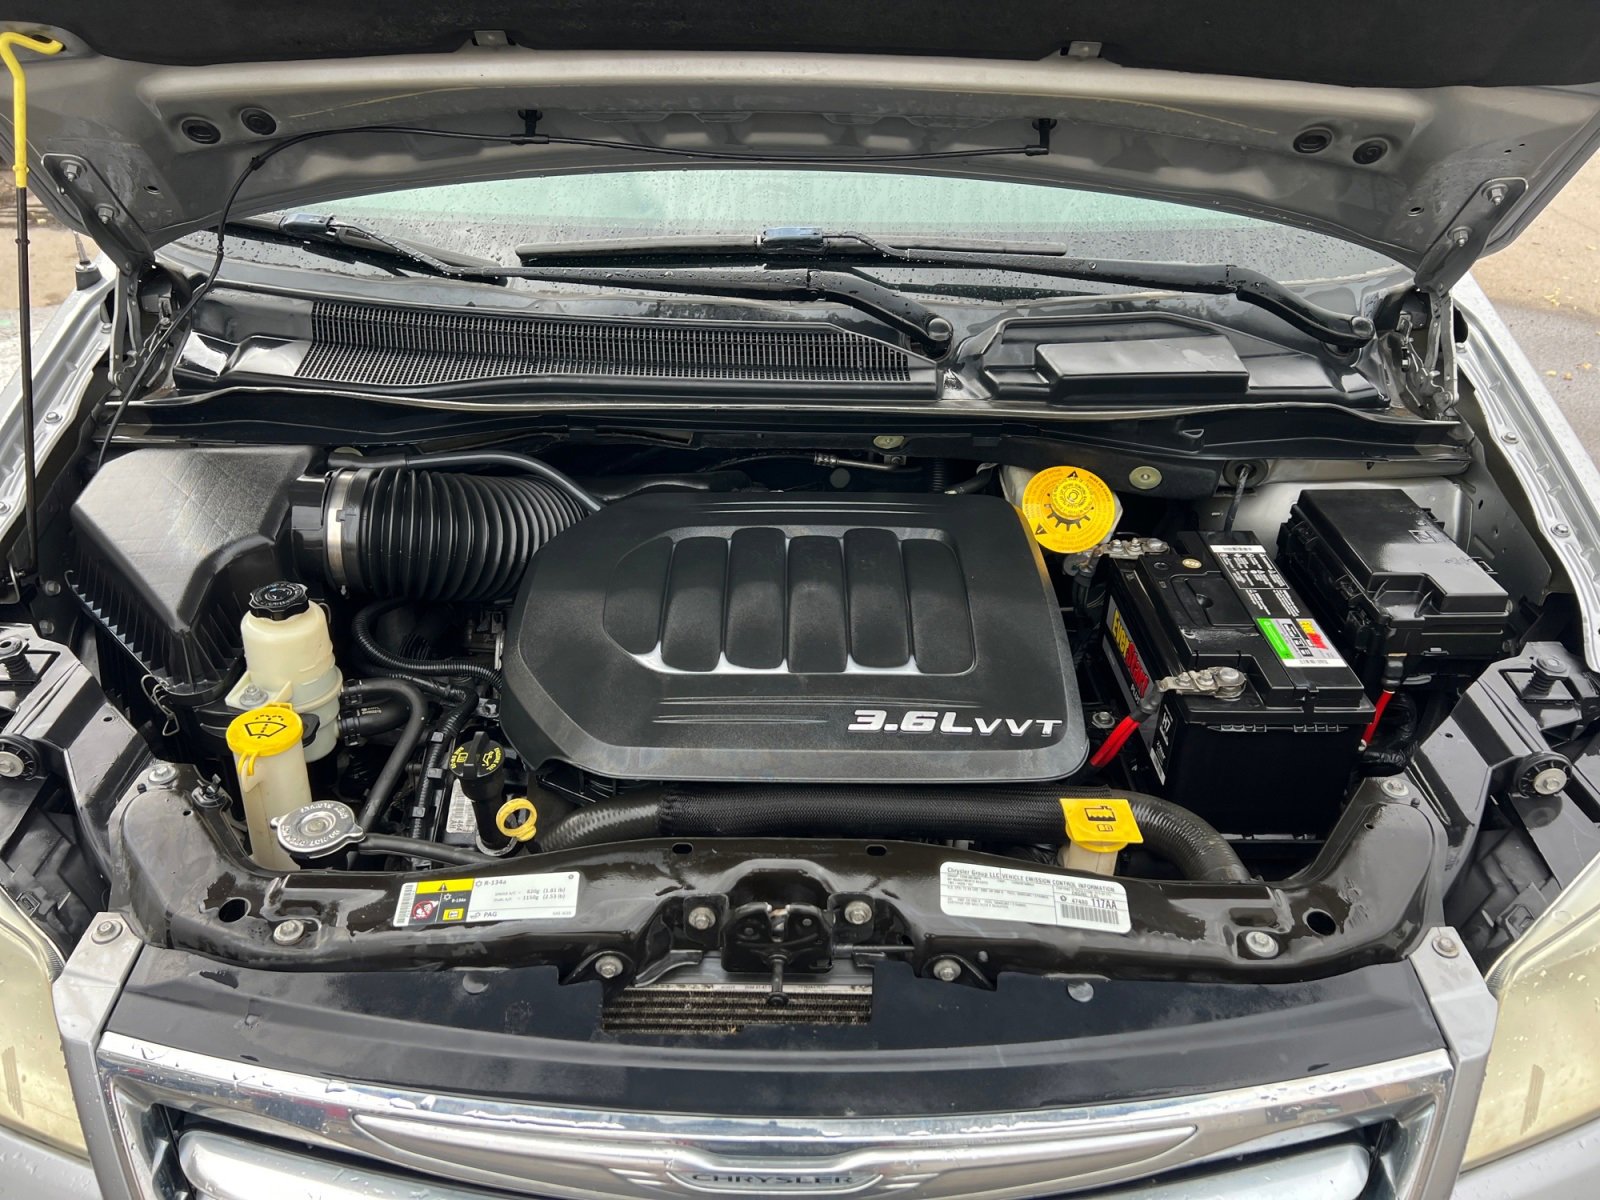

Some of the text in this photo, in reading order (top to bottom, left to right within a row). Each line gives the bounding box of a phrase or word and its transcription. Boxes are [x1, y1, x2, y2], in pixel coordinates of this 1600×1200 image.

[1112, 608, 1149, 698] EverStart
[848, 709, 1063, 737] 3.6L VVT
[947, 867, 970, 876] Chrysler
[971, 869, 988, 879] Group
[1001, 873, 1024, 881] VEHICLE
[1025, 875, 1051, 885] EMISSION
[1052, 879, 1076, 888] CONTROL
[1078, 883, 1115, 893] INFORMATION
[1092, 898, 1118, 909] 117AA
[692, 1173, 853, 1185] CHRYSLER
